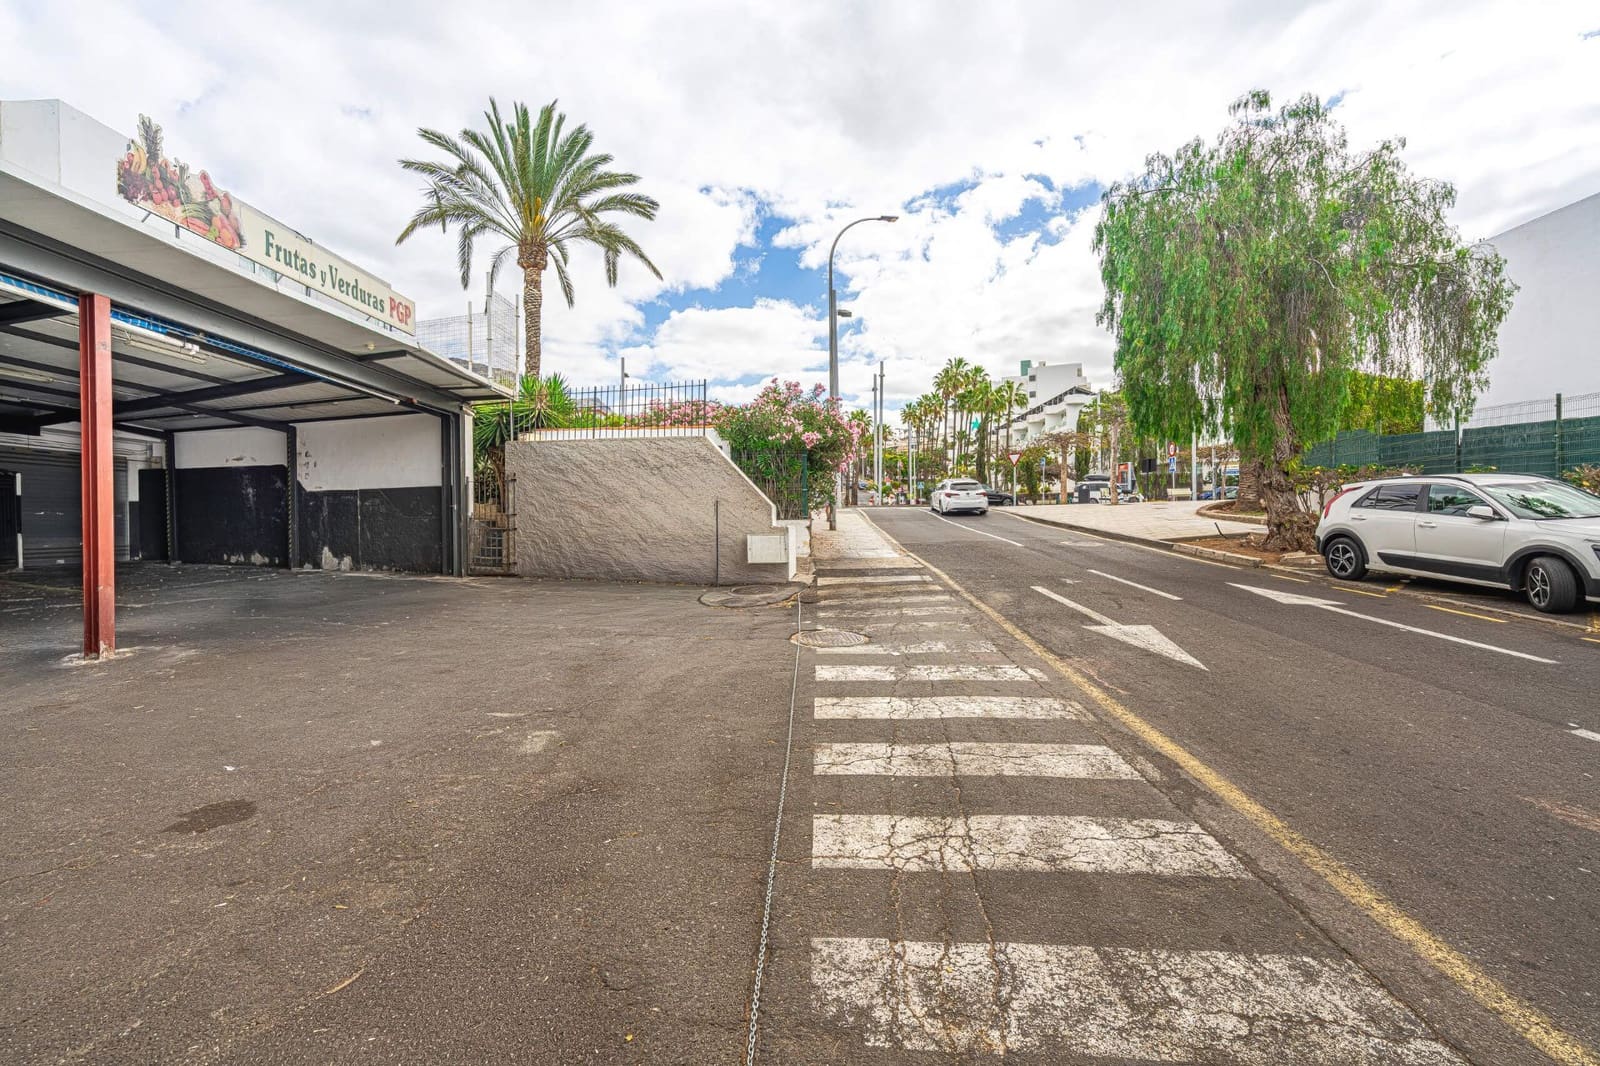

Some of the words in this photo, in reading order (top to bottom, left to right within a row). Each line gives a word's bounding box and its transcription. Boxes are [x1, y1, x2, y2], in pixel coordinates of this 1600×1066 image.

[265, 229, 317, 279] Frutas
[320, 269, 327, 287] y
[328, 264, 385, 314] Verduras
[389, 296, 412, 326] PGP
